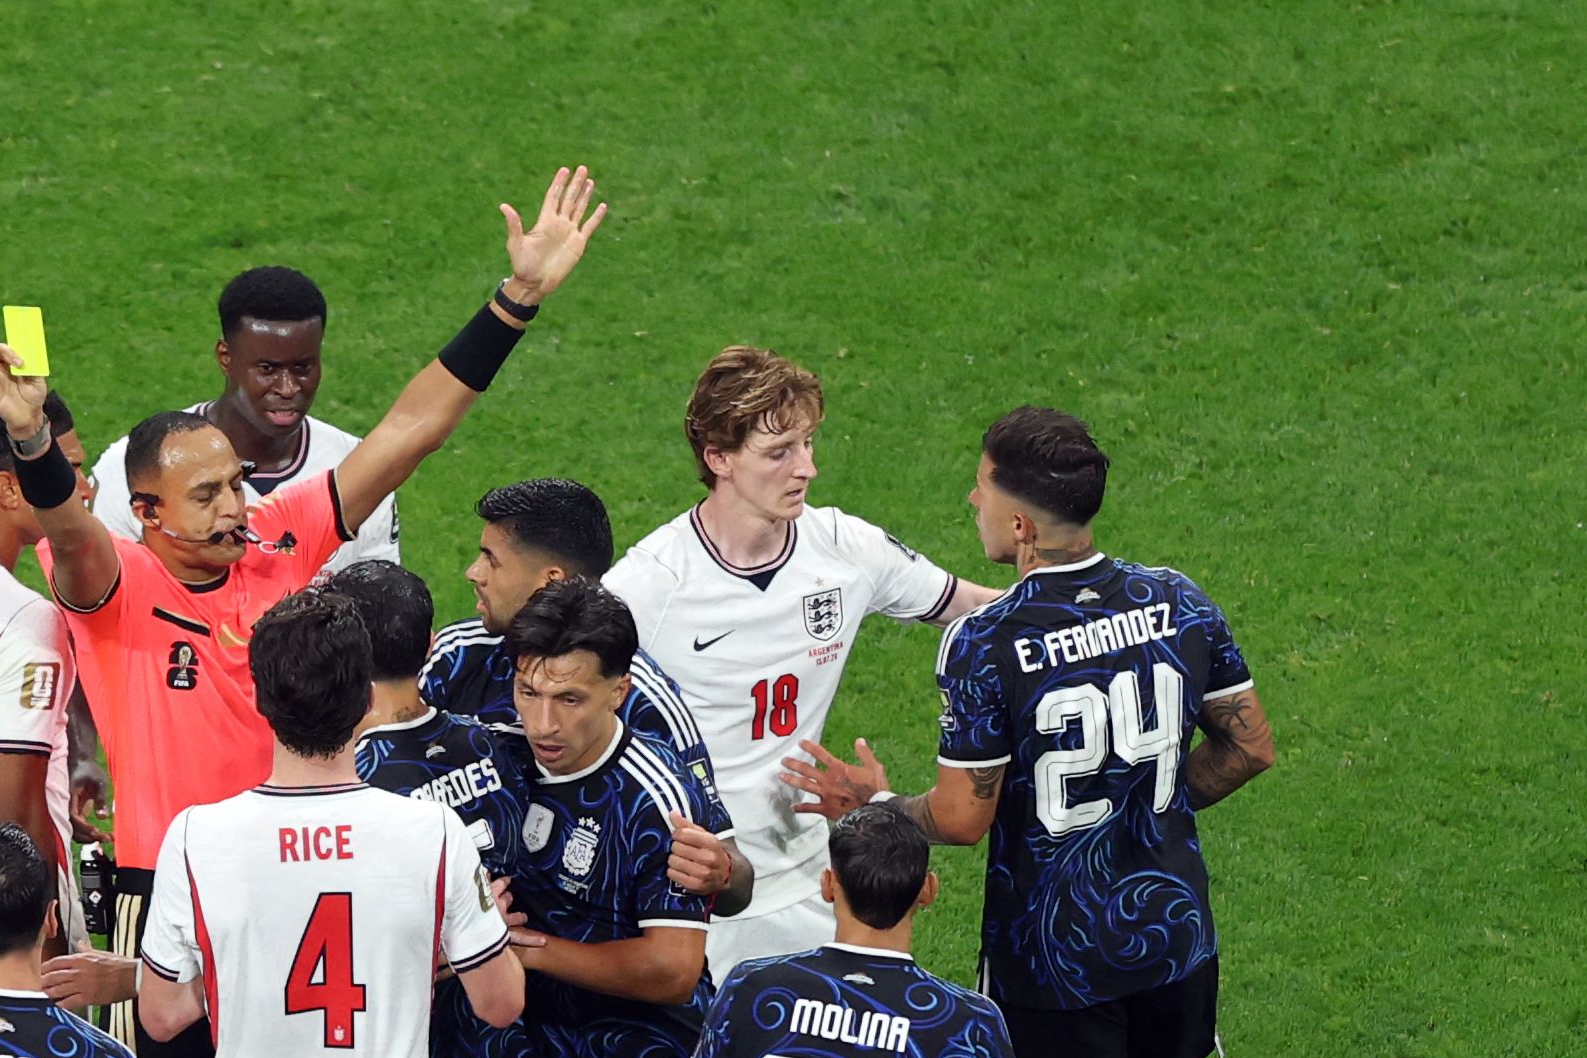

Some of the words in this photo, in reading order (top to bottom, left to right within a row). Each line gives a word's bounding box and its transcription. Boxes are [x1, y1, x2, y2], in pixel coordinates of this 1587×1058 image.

[808, 641, 844, 657] ARGENTINA
[750, 672, 800, 742] 18
[1034, 661, 1184, 837] 24
[279, 824, 354, 863] RICE
[284, 890, 367, 1050] 4
[789, 998, 911, 1053] MOLINA
